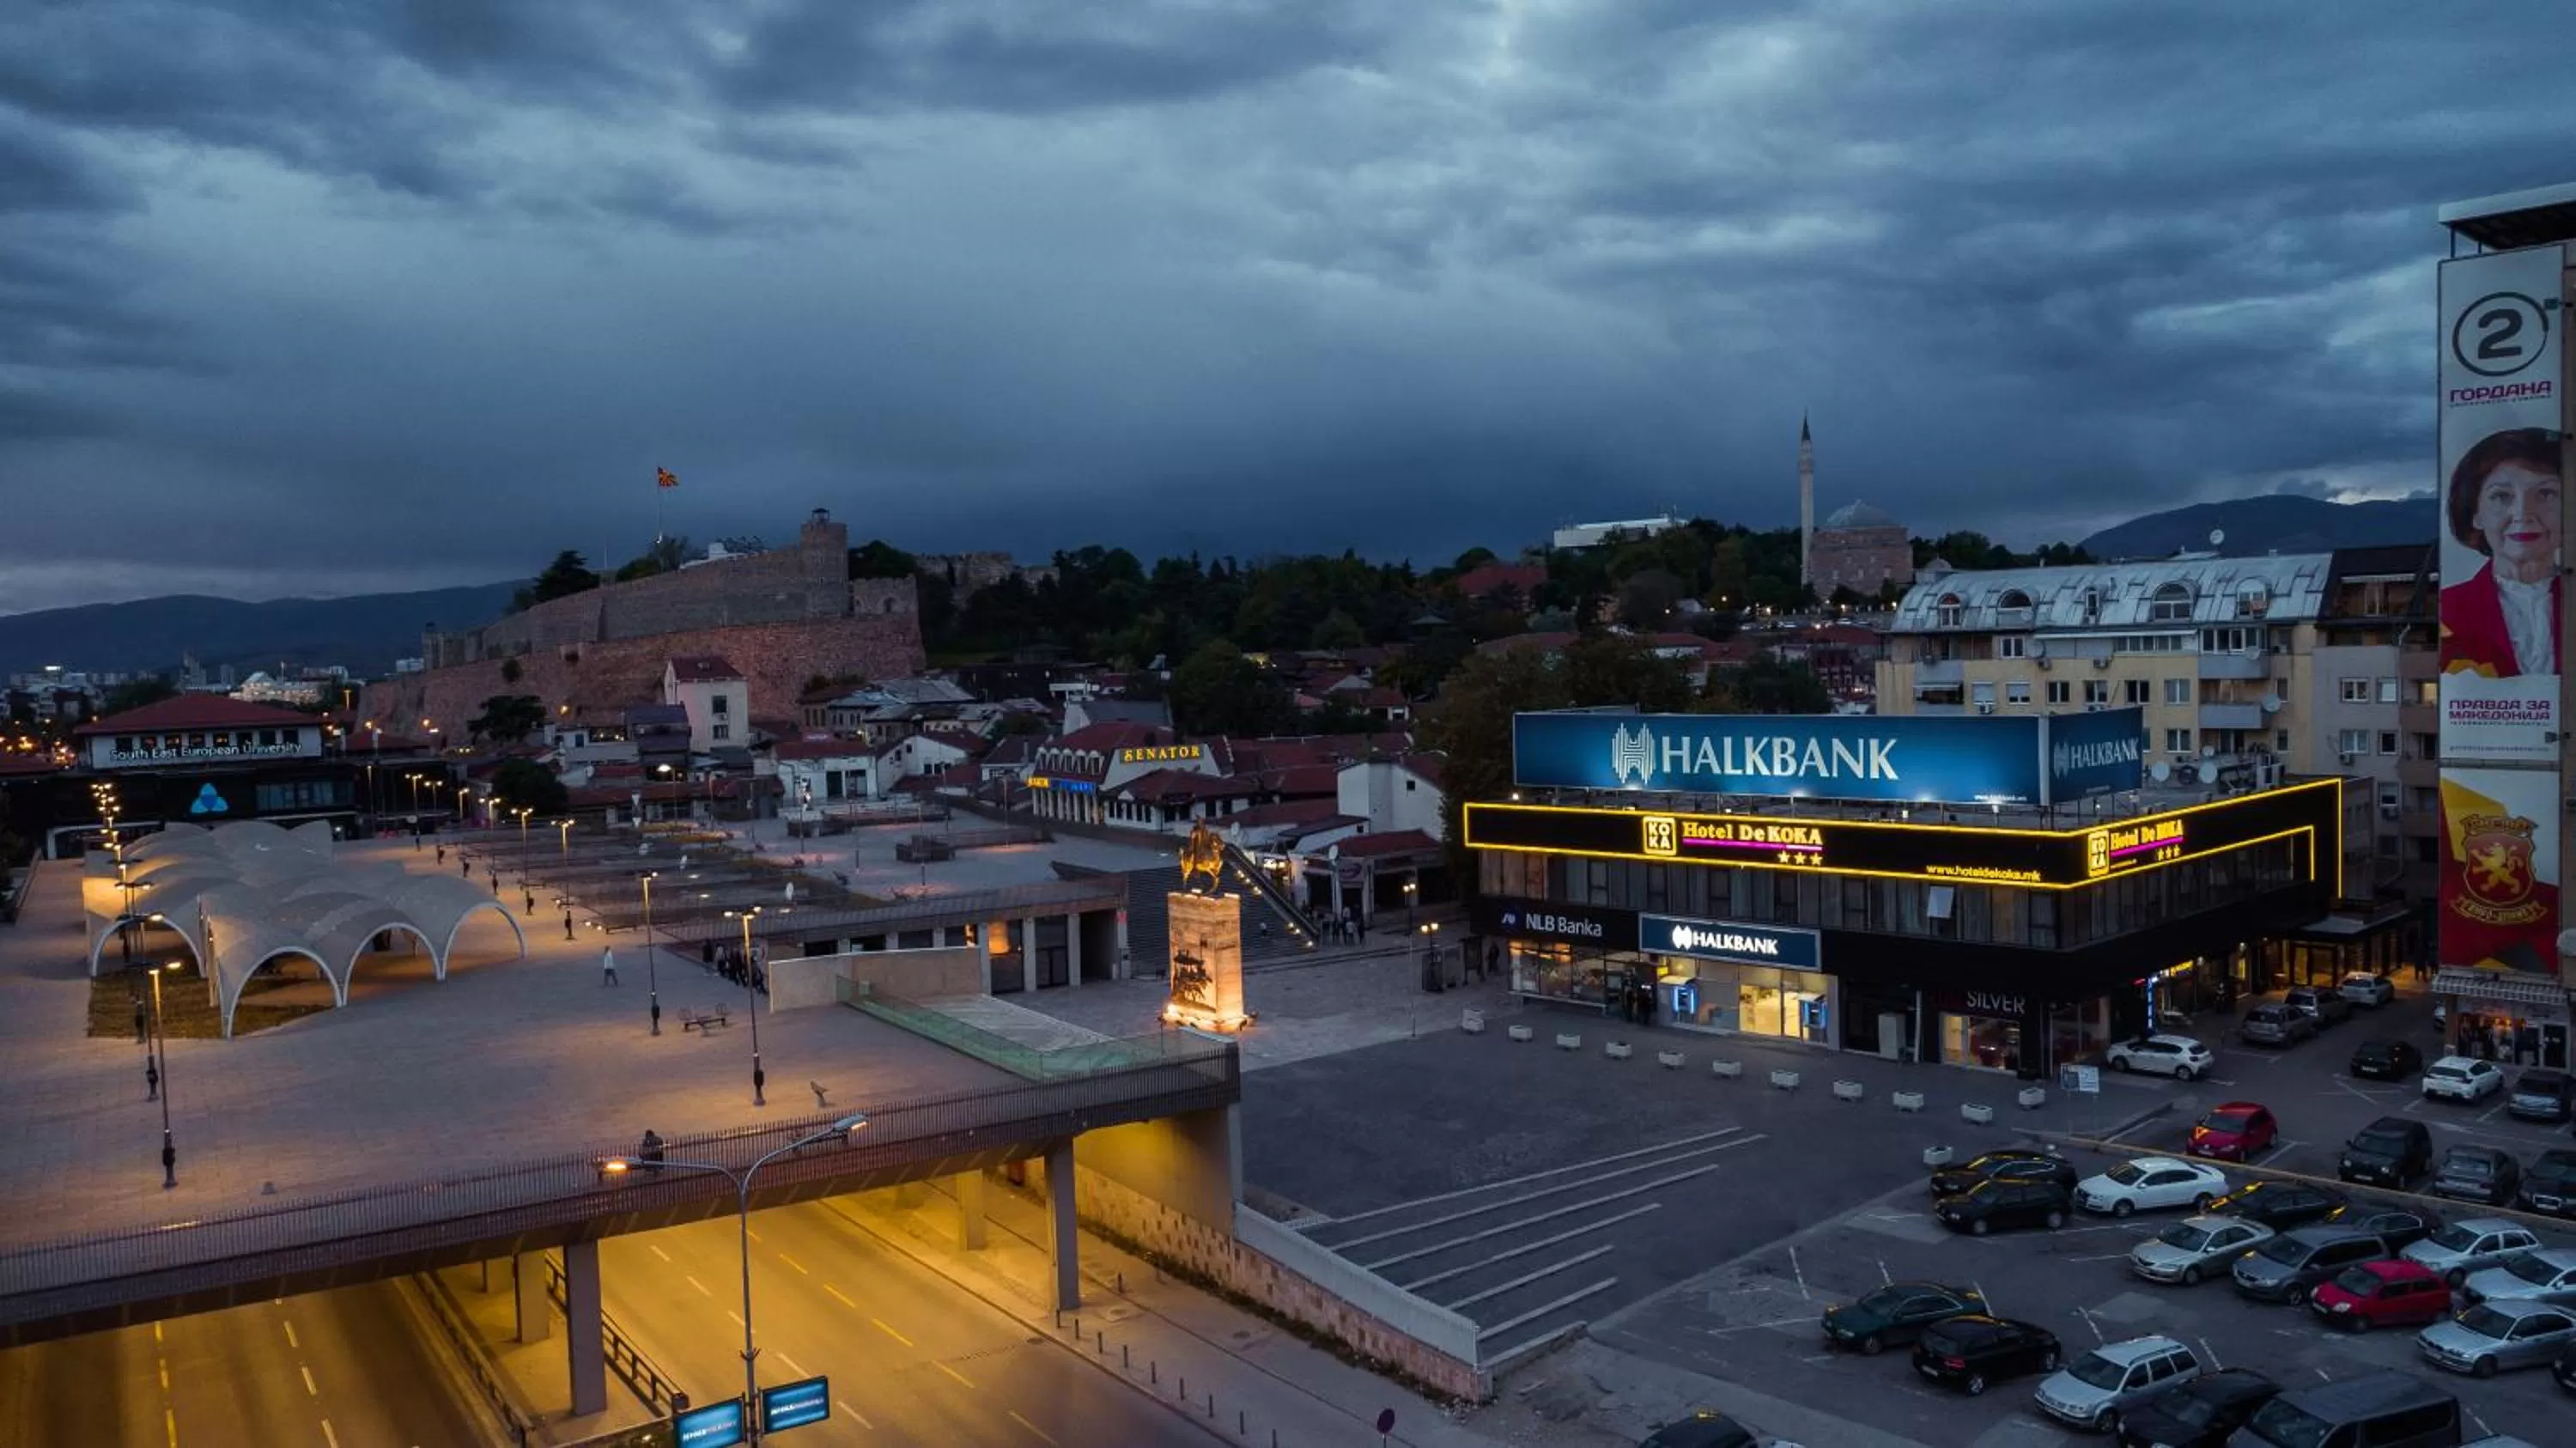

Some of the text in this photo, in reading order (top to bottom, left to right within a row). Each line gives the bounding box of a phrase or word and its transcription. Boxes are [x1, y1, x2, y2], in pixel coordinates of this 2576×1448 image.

[2478, 308, 2523, 360] 2
[2450, 380, 2552, 403] ГОРДАНА
[2449, 700, 2551, 710] ПРАВДА ЗА
[2449, 710, 2550, 721] МАКЕДОНИЈА
[110, 741, 302, 760] South East European University
[1123, 745, 1200, 763] SENATOR
[1661, 736, 1899, 781] HALKBANK
[2070, 737, 2140, 770] HALKBANK
[1681, 821, 1734, 840] Hotel
[1525, 913, 1603, 938] NLB Banka
[1692, 931, 1779, 956] HALKBANK
[1966, 989, 2026, 1015] SILVER
